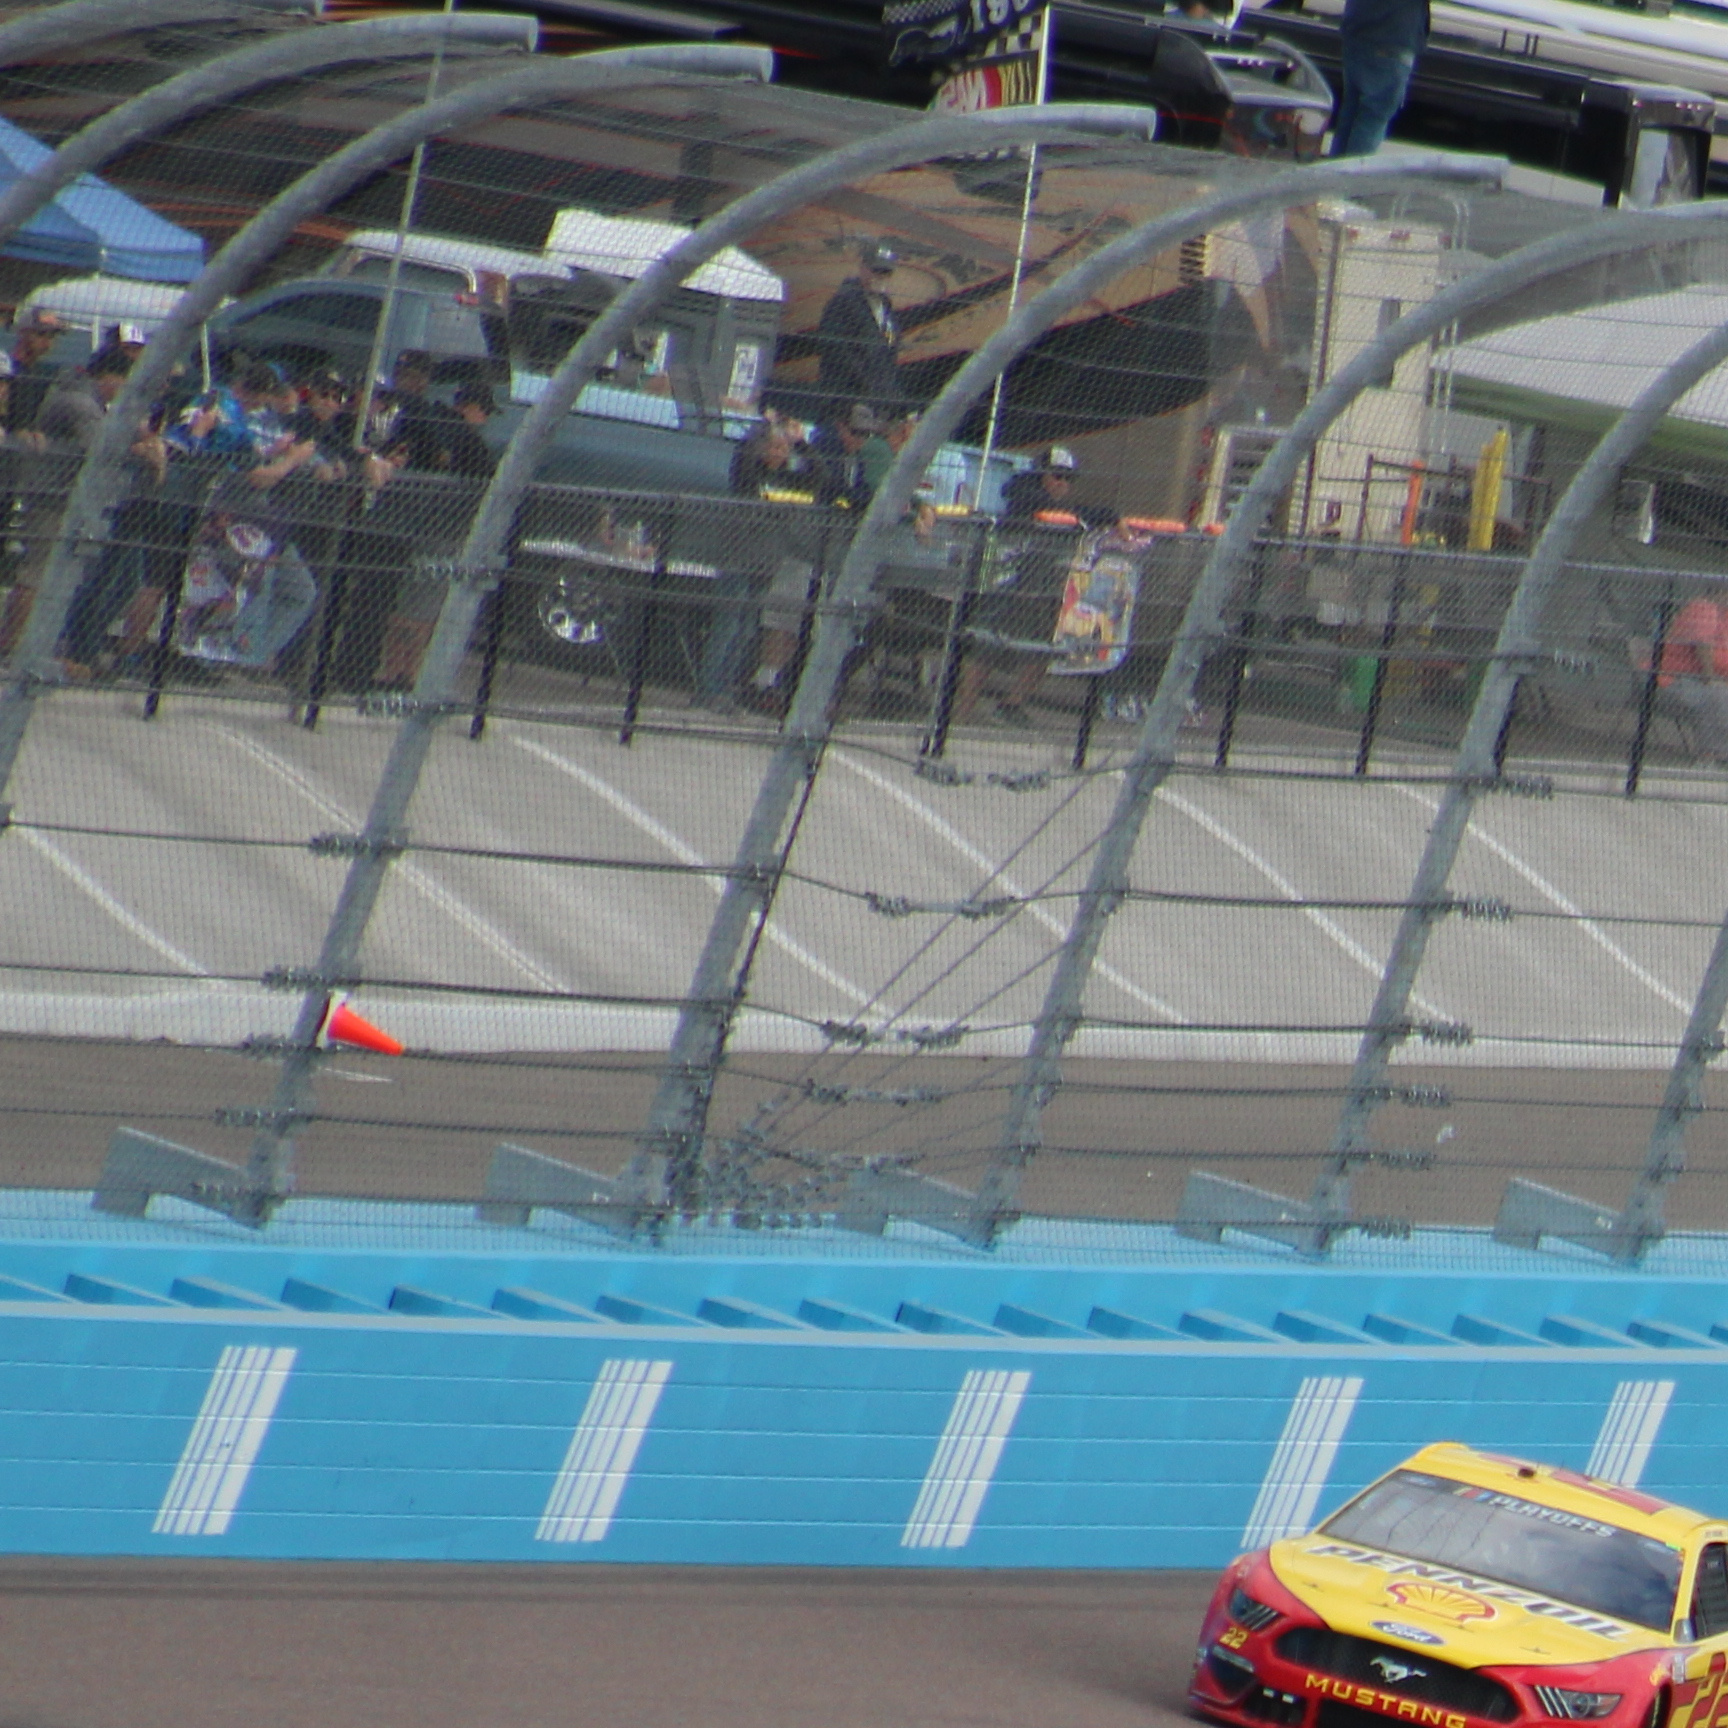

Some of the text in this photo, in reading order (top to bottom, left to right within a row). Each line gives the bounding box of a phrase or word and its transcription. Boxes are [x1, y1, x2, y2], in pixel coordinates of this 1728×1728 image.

[1491, 1496, 1618, 1538] PLAYOFFS
[1304, 1543, 1634, 1641] PENNZOIL
[1219, 1627, 1249, 1649] 22
[1382, 1622, 1435, 1643] Ford
